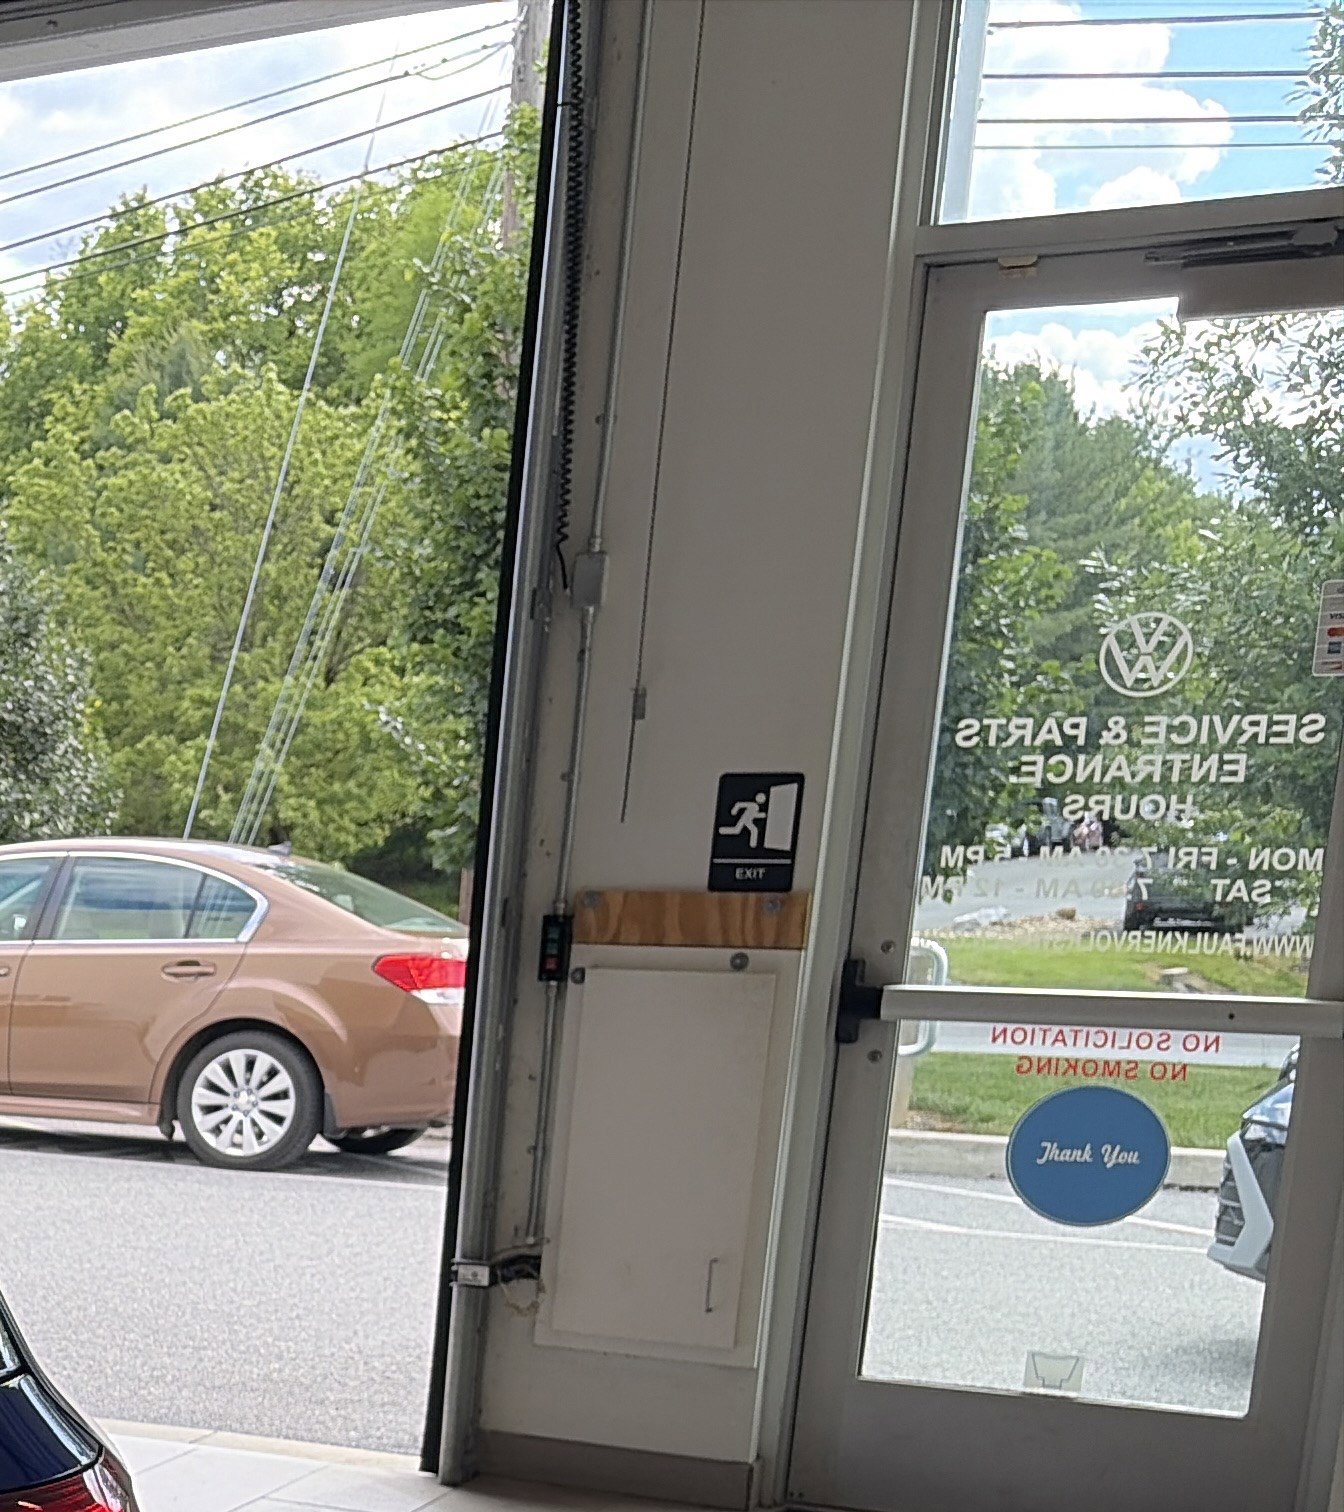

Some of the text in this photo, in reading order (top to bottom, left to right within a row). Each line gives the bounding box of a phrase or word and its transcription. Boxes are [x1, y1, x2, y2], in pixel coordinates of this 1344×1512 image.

[734, 867, 767, 881] EXIT
[1035, 1141, 1141, 1168] Thank You
